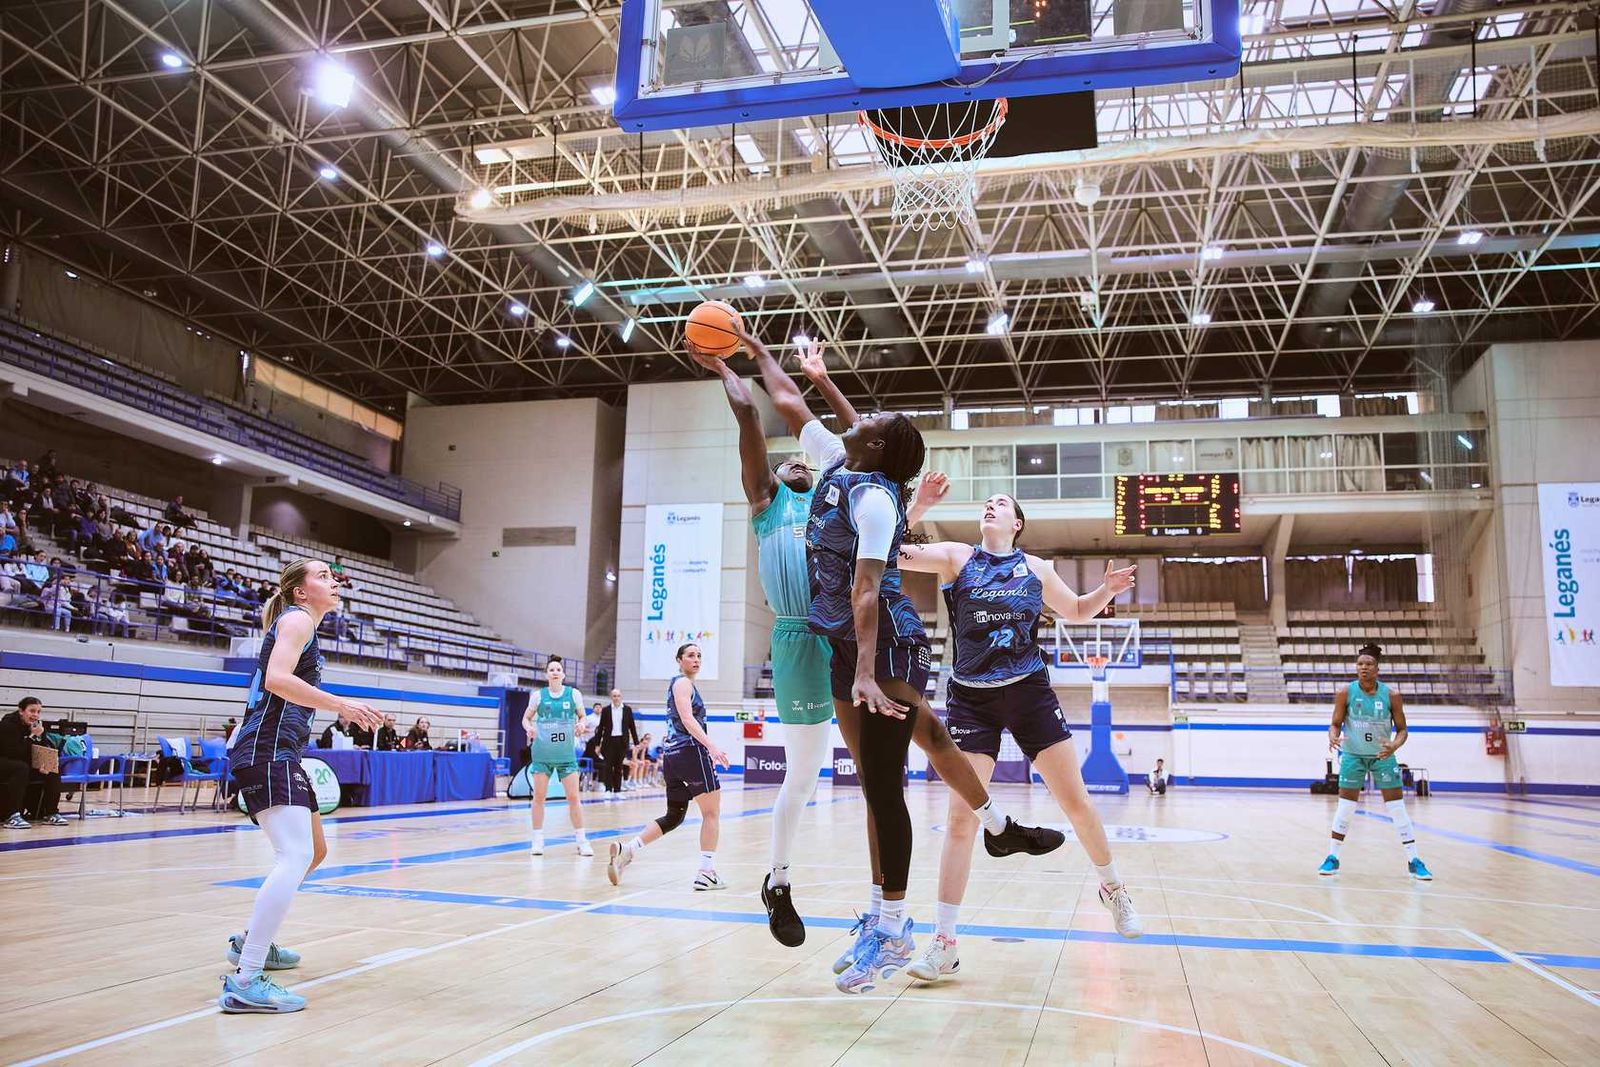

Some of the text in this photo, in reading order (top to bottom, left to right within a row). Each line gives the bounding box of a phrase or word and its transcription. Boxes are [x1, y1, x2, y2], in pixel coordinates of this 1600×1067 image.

[1549, 528, 1579, 618] Leganés
[647, 543, 667, 621] Leganés
[970, 587, 1028, 601] Leganés
[551, 732, 566, 742] 20
[1364, 732, 1373, 742] 6
